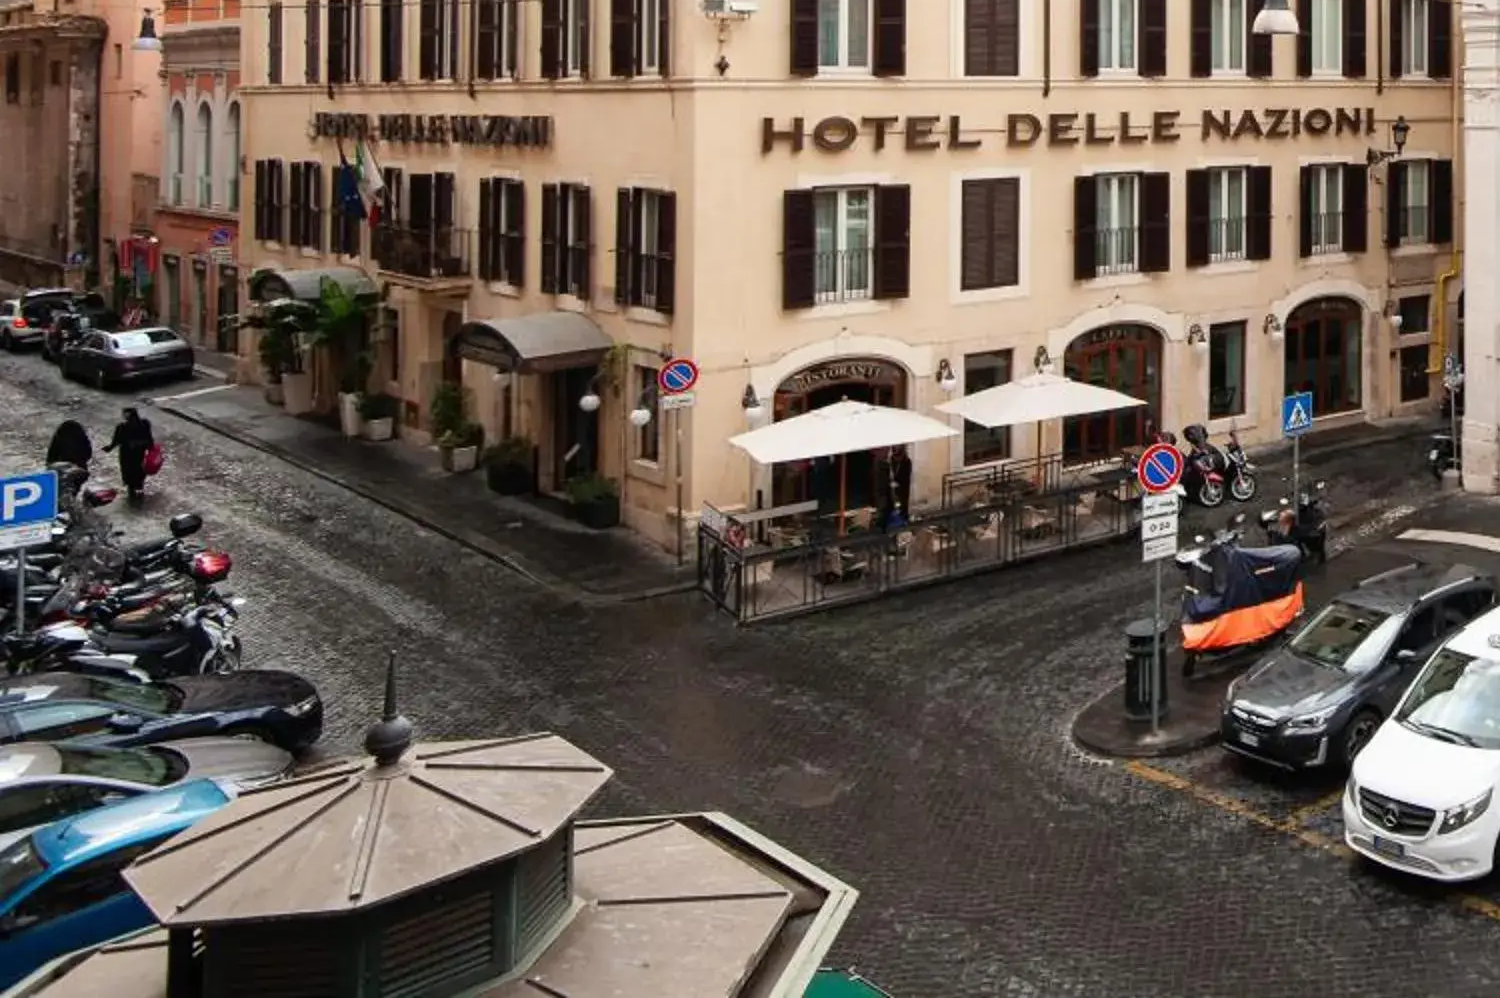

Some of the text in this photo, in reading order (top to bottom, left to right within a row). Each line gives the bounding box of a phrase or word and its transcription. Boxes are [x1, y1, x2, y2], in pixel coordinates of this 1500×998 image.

[761, 107, 1377, 154] HOTEL DELLE NAZIONI
[3, 481, 42, 521] P
